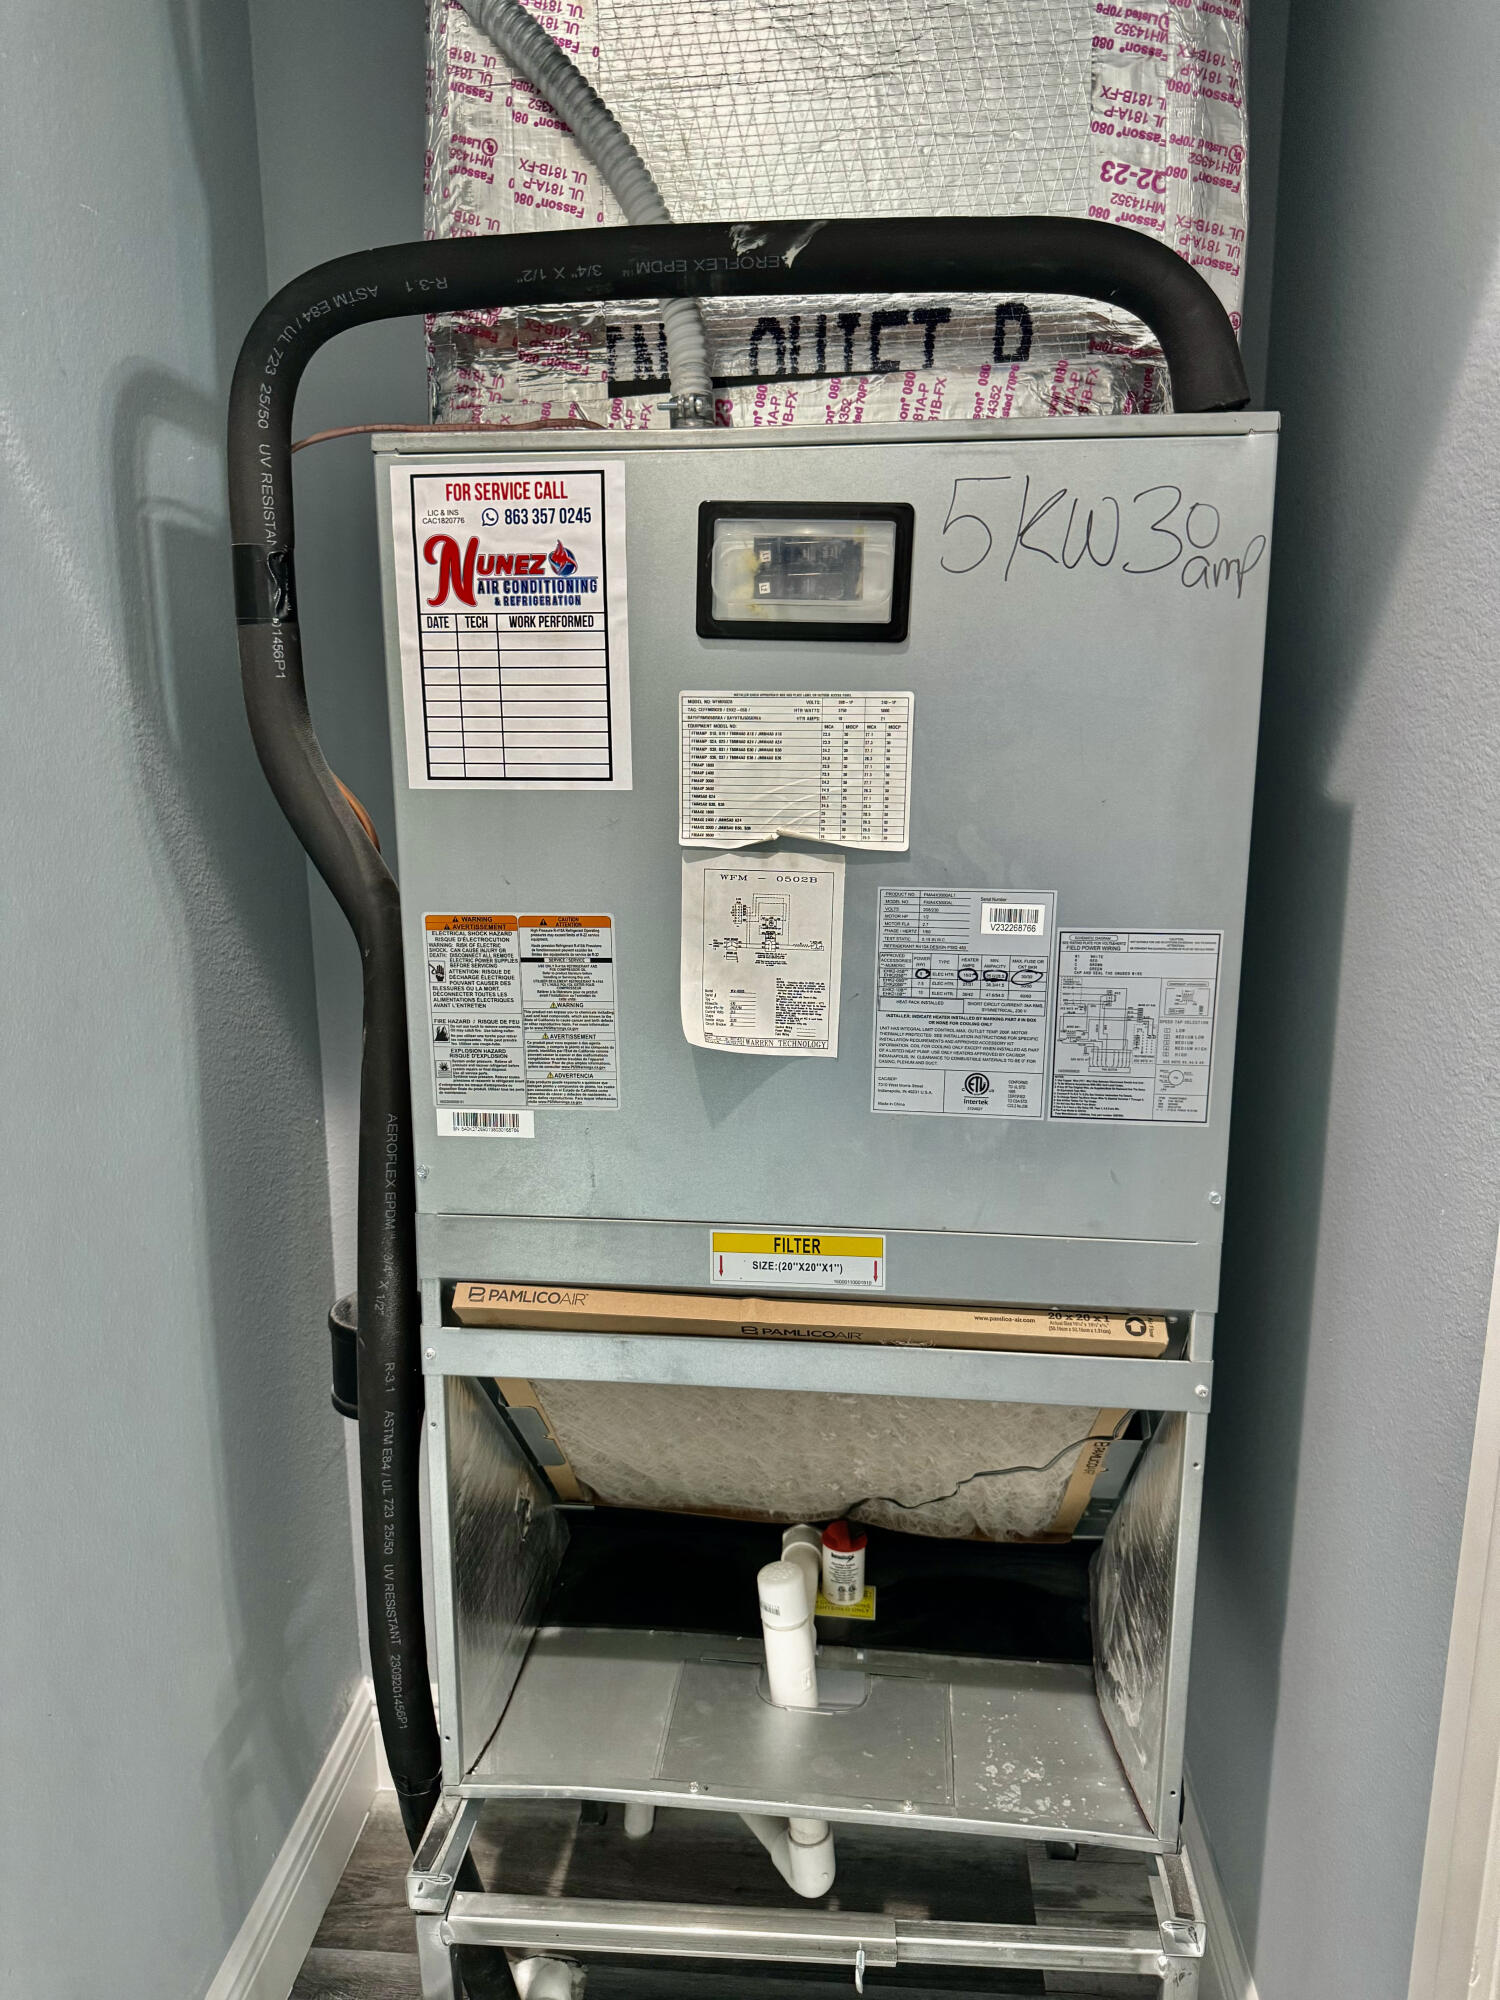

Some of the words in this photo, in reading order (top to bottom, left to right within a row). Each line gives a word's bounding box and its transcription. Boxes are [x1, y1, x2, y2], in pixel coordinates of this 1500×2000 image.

[1092, 35, 1114, 50] 080
[1100, 85, 1153, 107] 181B-FX
[1103, 105, 1149, 124] 181A-P
[1091, 120, 1115, 135] 080
[518, 158, 567, 180] 181B-FX
[572, 170, 587, 185] UL
[1165, 165, 1188, 180] 080
[523, 178, 564, 196] 181A-P
[569, 187, 584, 201] UL
[1088, 205, 1110, 220] 080
[1110, 193, 1166, 215] MH14352
[1174, 214, 1225, 236] 181B-FX
[1228, 226, 1245, 242] UL
[1178, 234, 1221, 253] 181A-P
[1225, 243, 1241, 259] UL
[693, 254, 780, 272] EROFLEX
[404, 276, 448, 293] R-3.1
[333, 285, 379, 308] ASTM
[277, 326, 297, 343] UL
[265, 347, 285, 376] 723
[257, 382, 273, 430] 25/50
[259, 444, 272, 468] UV
[446, 483, 471, 501] FOR
[474, 482, 530, 501] SERVICE
[534, 481, 568, 499] CALL
[261, 472, 277, 546] RESISTAN
[505, 508, 528, 525] 863
[532, 508, 555, 524] 357
[560, 507, 591, 524] 0245
[1180, 534, 1264, 599] amp
[477, 580, 499, 595] AIR
[503, 579, 597, 594] CONDITIONING
[494, 596, 501, 606] &
[503, 595, 581, 606] REFRIGERATION
[427, 616, 450, 628] DATE
[465, 616, 489, 628] TECH
[509, 615, 535, 628] WORK
[539, 615, 594, 628] PERFORMED
[990, 924, 1036, 932] V232268766
[778, 1040, 826, 1049] TECHNOLOGY
[384, 1113, 398, 1188] AEROFLEX
[774, 1237, 821, 1254] FILTER
[974, 1315, 1036, 1323] www.pamlico-air.com
[1048, 1312, 1062, 1320] 20
[1075, 1313, 1089, 1321] 20
[762, 1328, 863, 1340] PAMLICOAIR
[384, 1362, 395, 1392] R-3.1
[383, 1410, 395, 1444] ASTM
[381, 1448, 393, 1470] E84
[381, 1480, 393, 1495] UL
[383, 1499, 394, 1518] 723
[383, 1524, 395, 1554] 25/50
[383, 1564, 395, 1580] UV
[384, 1583, 401, 1645] RESISTANT
